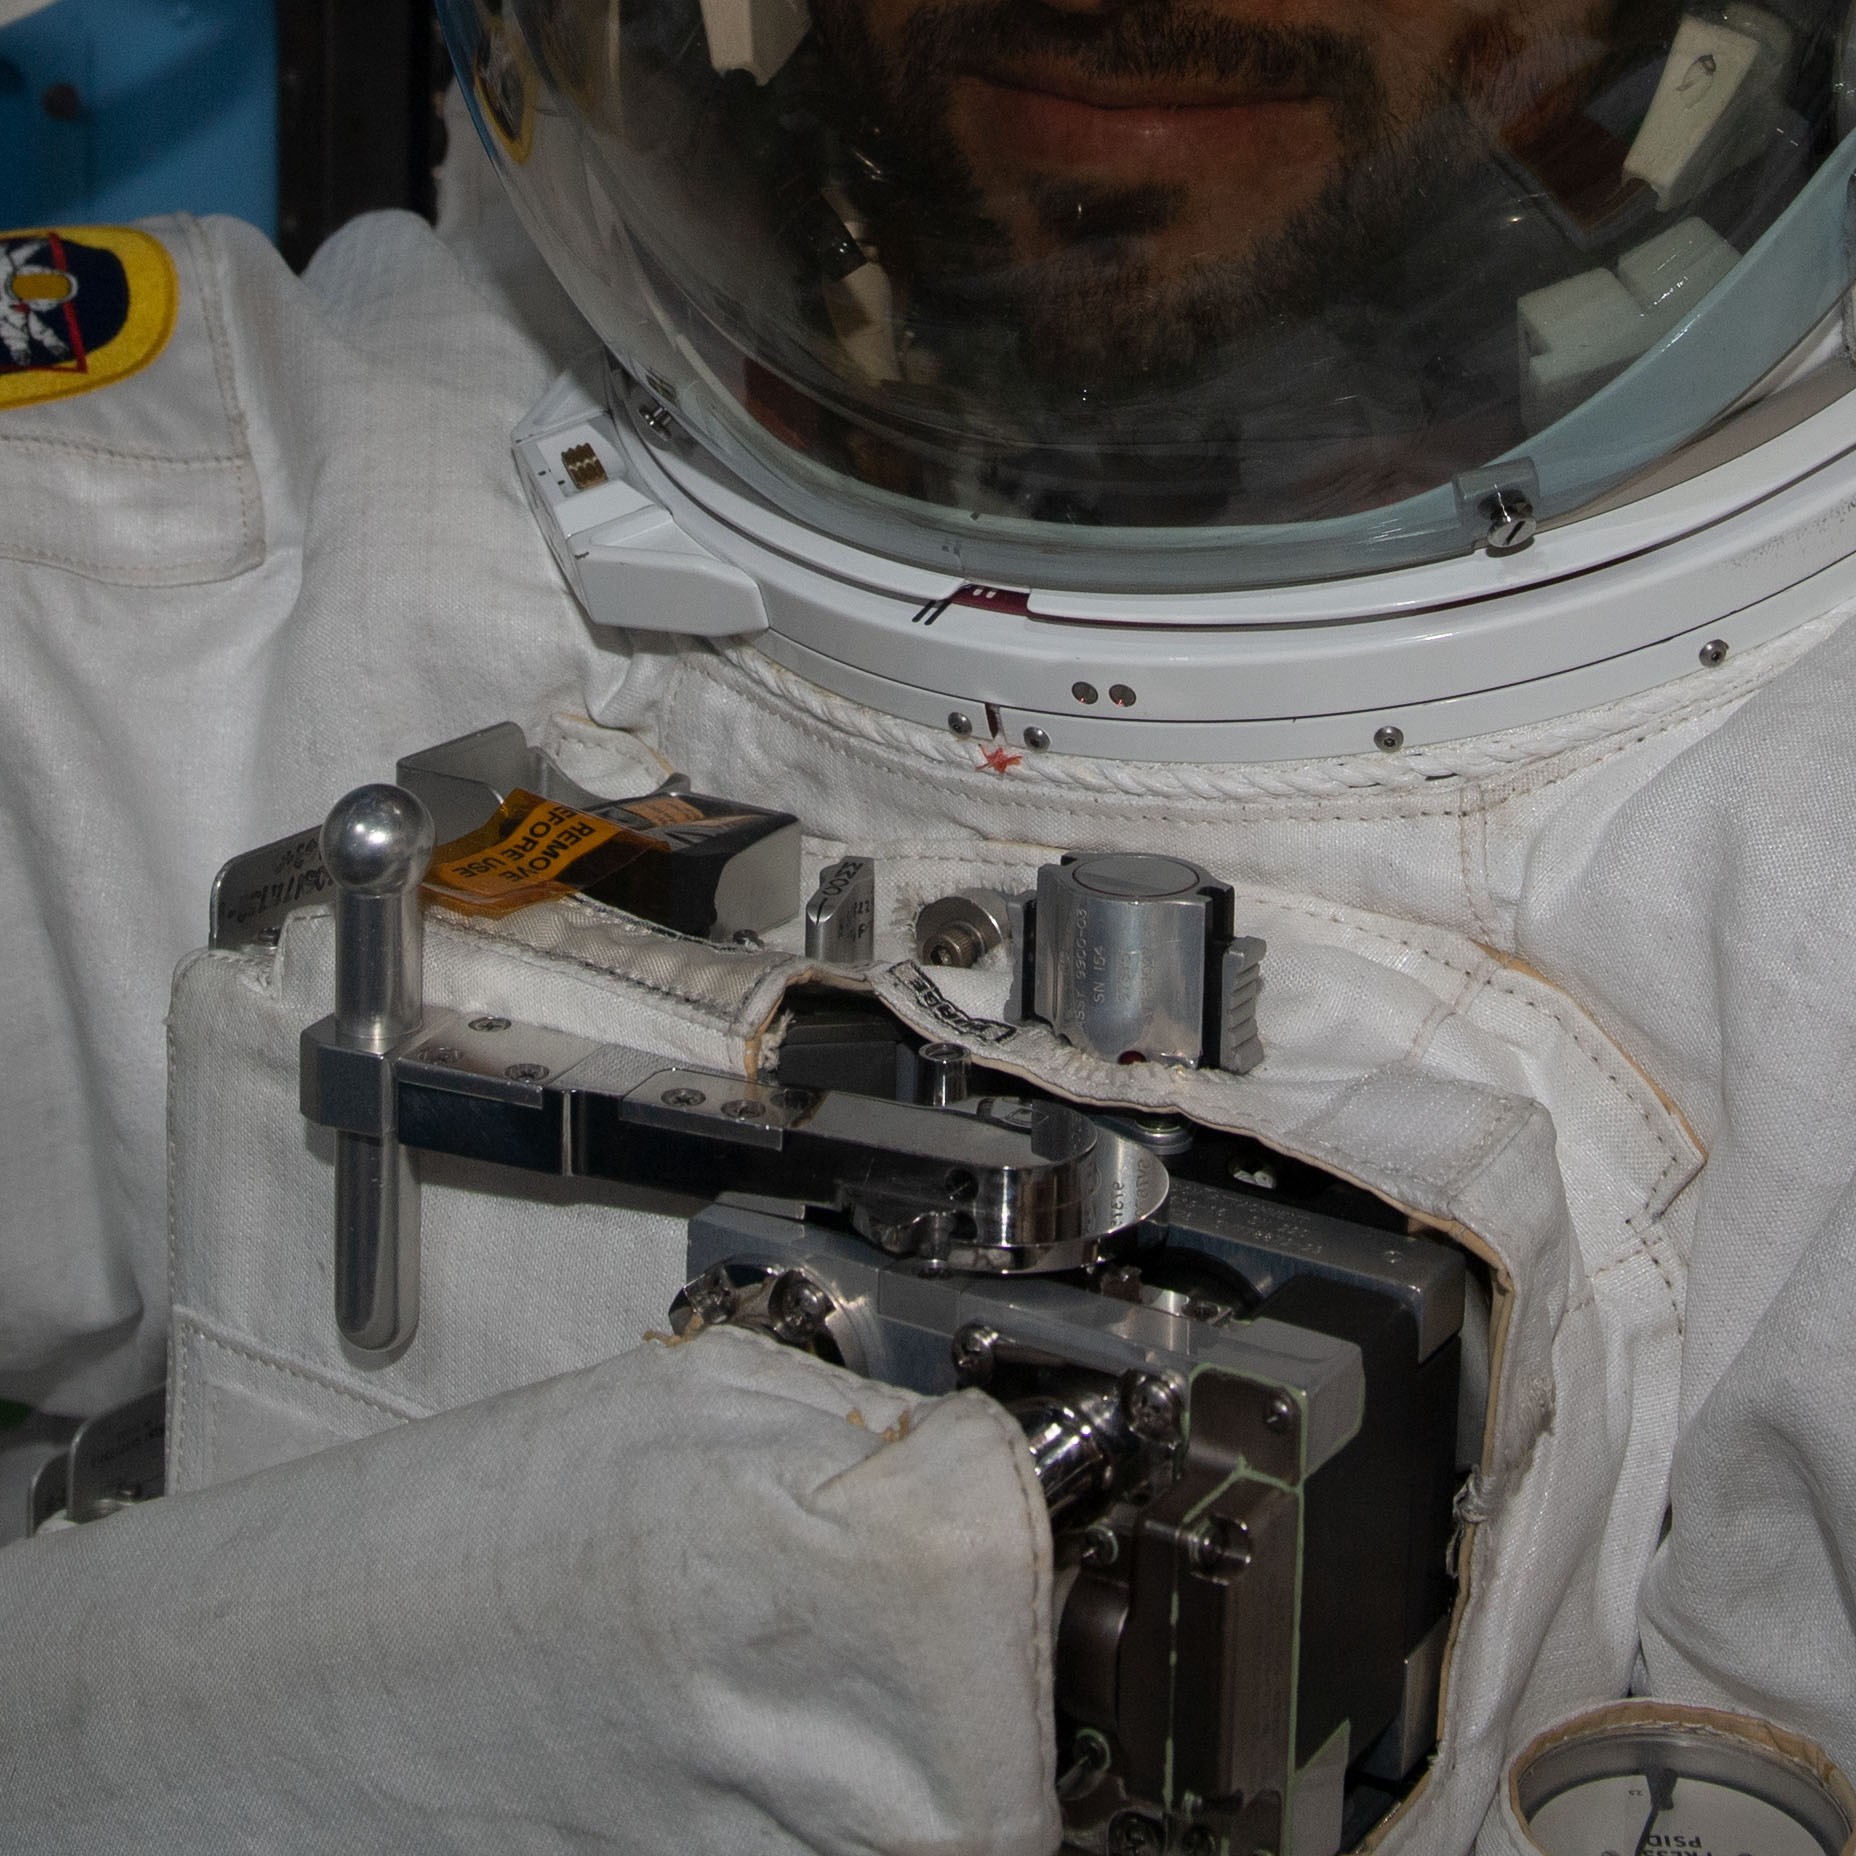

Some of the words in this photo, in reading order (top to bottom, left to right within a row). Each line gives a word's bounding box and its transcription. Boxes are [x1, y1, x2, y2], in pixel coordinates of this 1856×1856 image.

[501, 806, 577, 862] EFORE
[498, 820, 596, 882] REMOVE
[451, 856, 506, 878] USE
[1093, 981, 1105, 1003] SN
[1646, 1835, 1702, 1848] PSID
